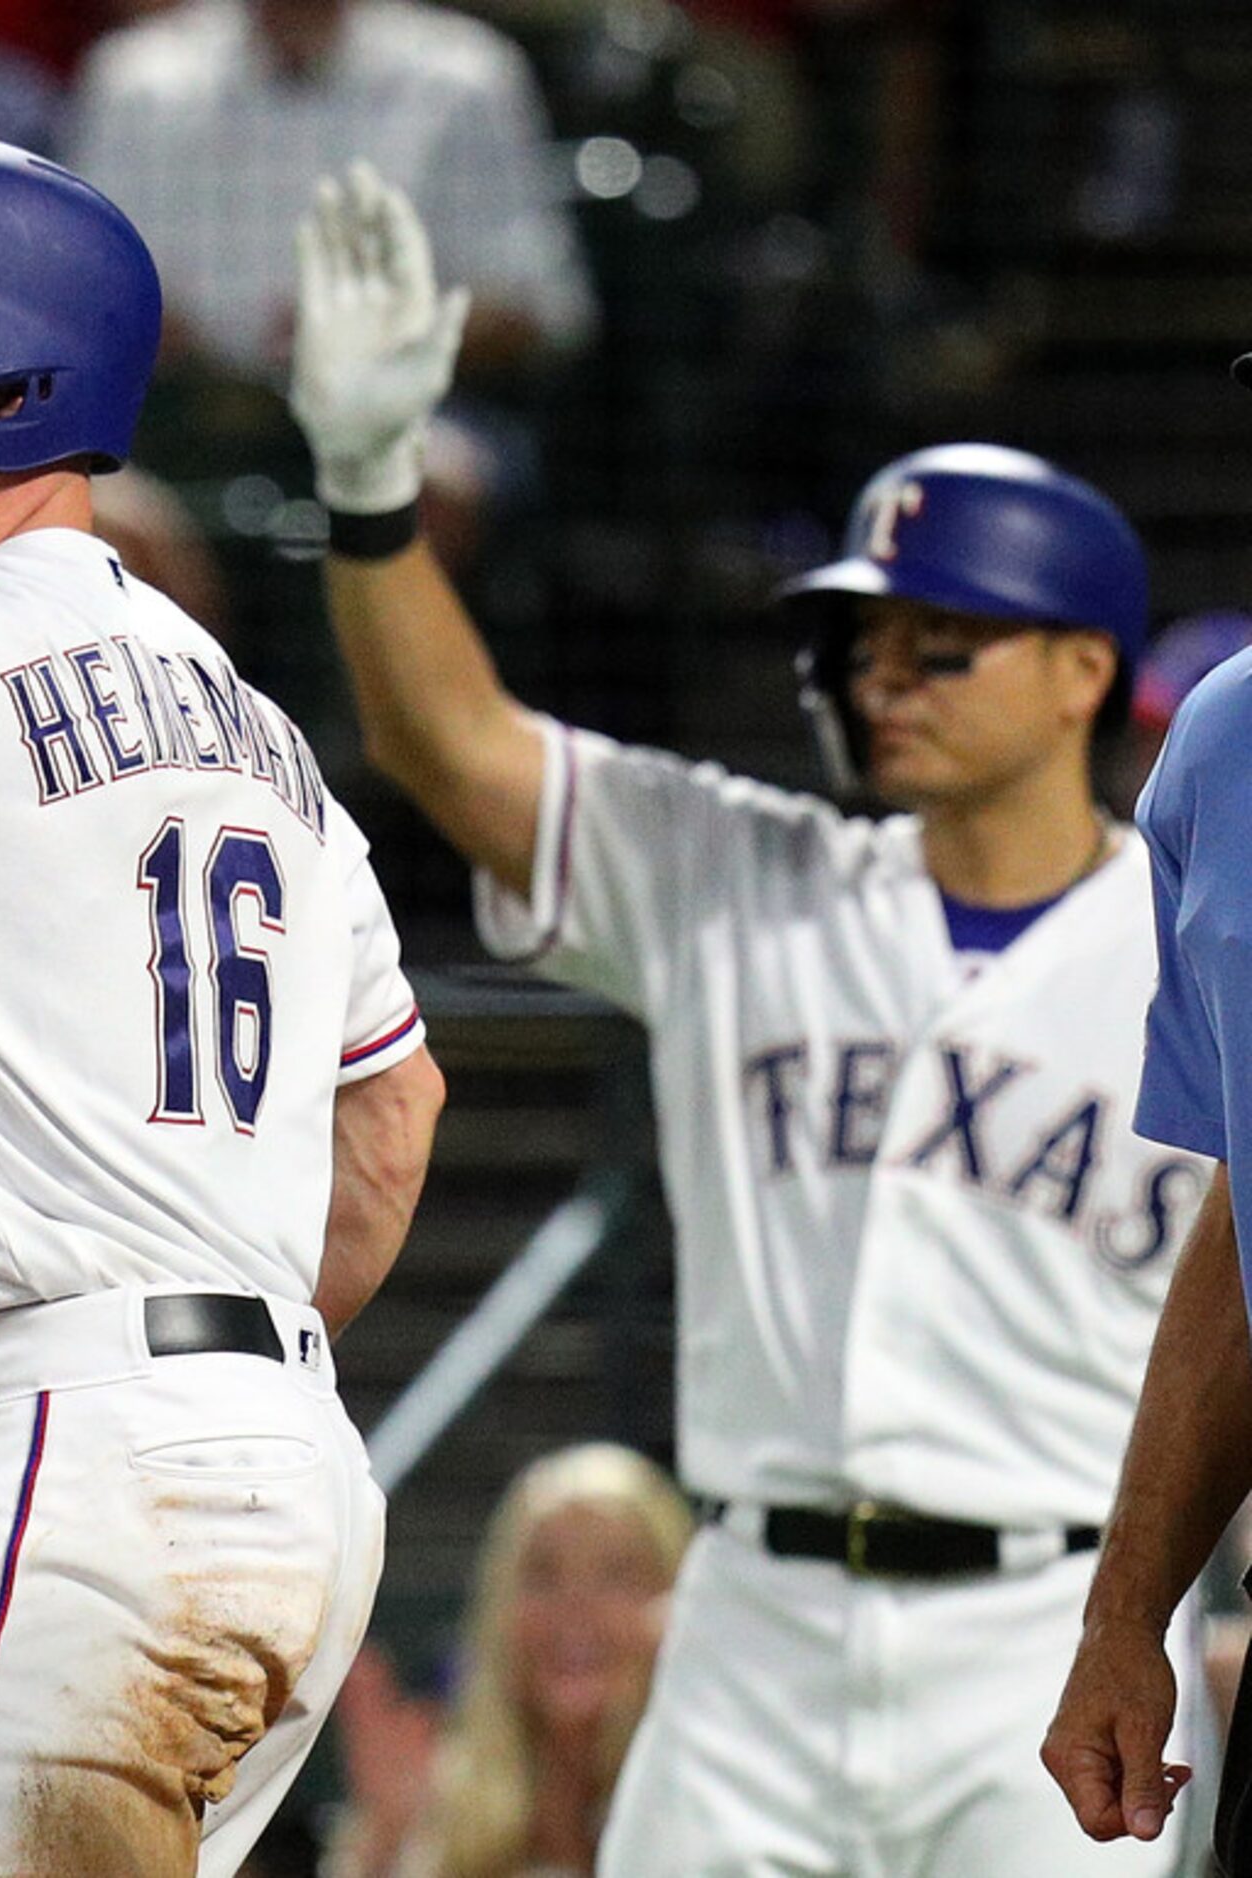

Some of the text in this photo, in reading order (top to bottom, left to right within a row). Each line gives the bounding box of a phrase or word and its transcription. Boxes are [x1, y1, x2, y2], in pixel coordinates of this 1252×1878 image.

[860, 477, 924, 562] T
[136, 816, 286, 1138] 16
[742, 1036, 1207, 1271] TEXAS
